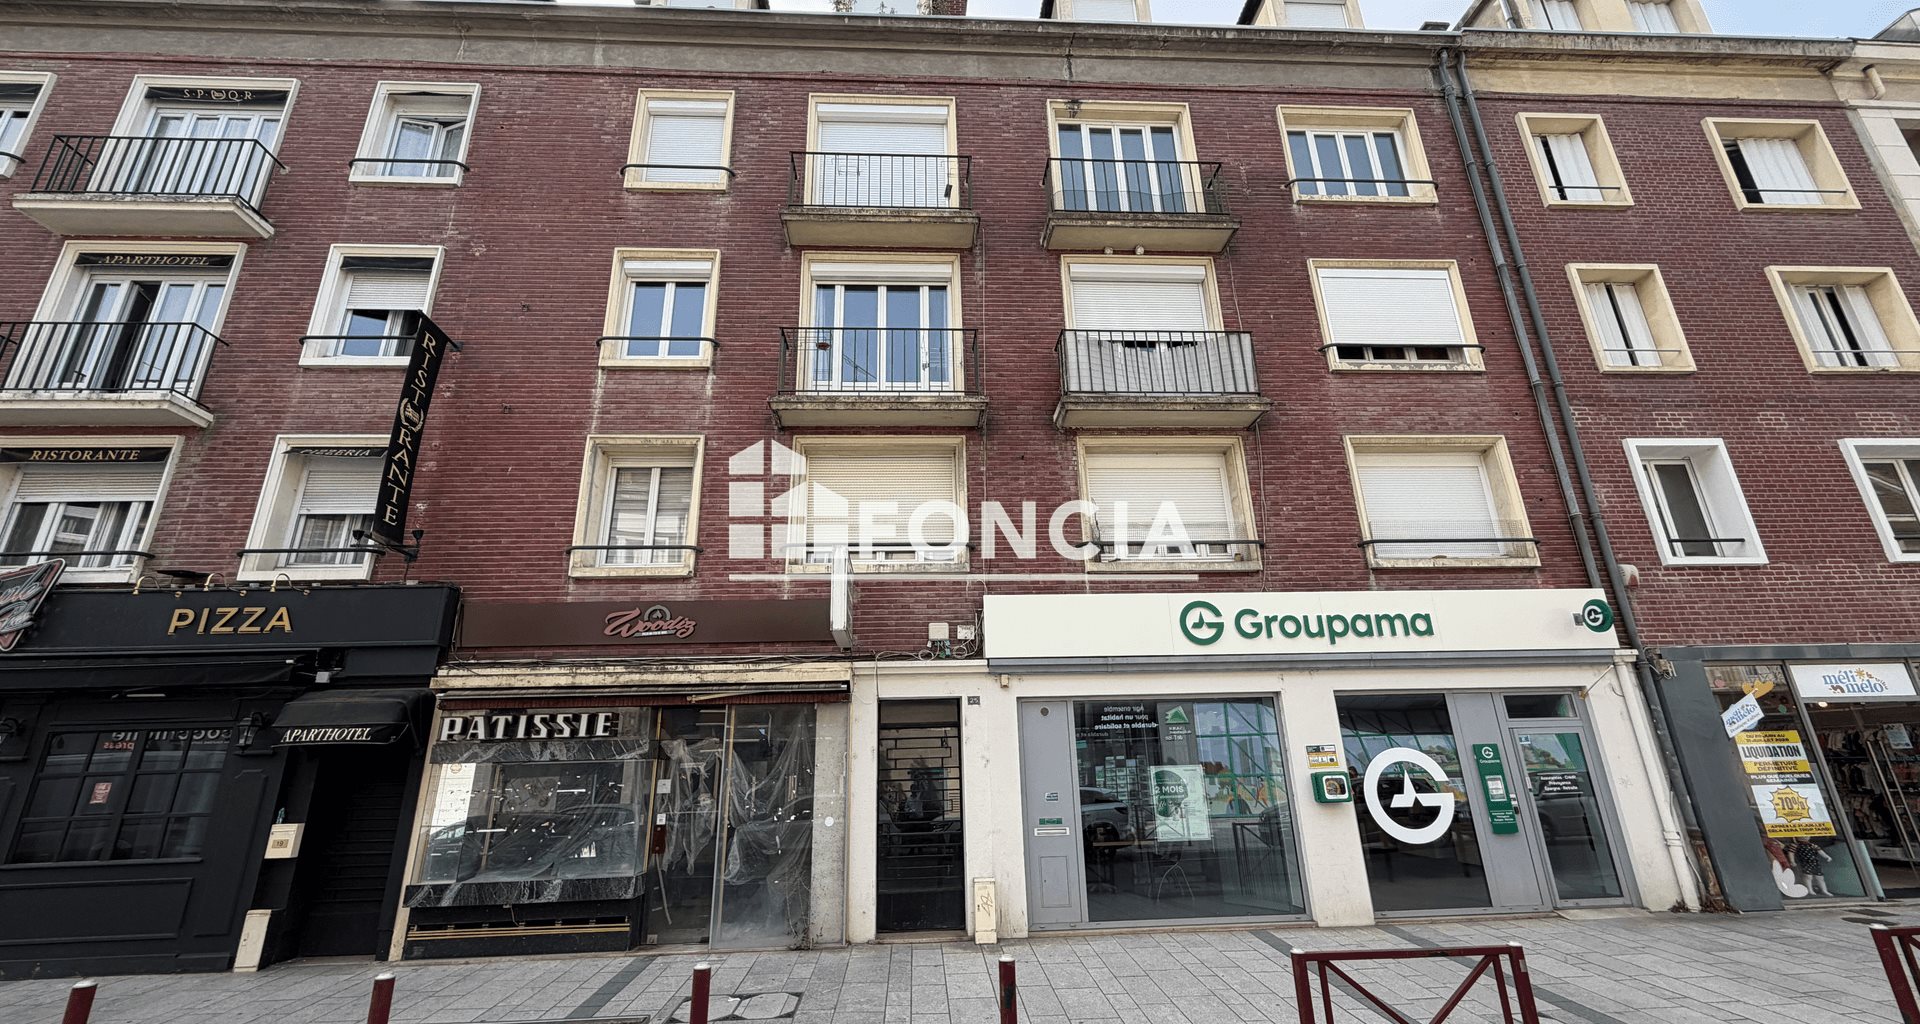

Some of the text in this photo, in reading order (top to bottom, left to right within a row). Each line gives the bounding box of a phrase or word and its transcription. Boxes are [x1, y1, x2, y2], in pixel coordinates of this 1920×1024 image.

[99, 254, 210, 266] APARTHOTEL
[28, 449, 141, 461] RISTORANTE
[167, 606, 294, 636] PIZZA
[604, 606, 697, 639] Woodiz
[1235, 608, 1435, 645] Groupama
[1823, 670, 1857, 685] méli
[1845, 679, 1884, 694] mélo
[440, 711, 616, 742] PATISSIE
[281, 727, 372, 743] APARTHOTEL
[1741, 744, 1802, 759] LIQUIDATION
[1162, 785, 1184, 794] MOIS
